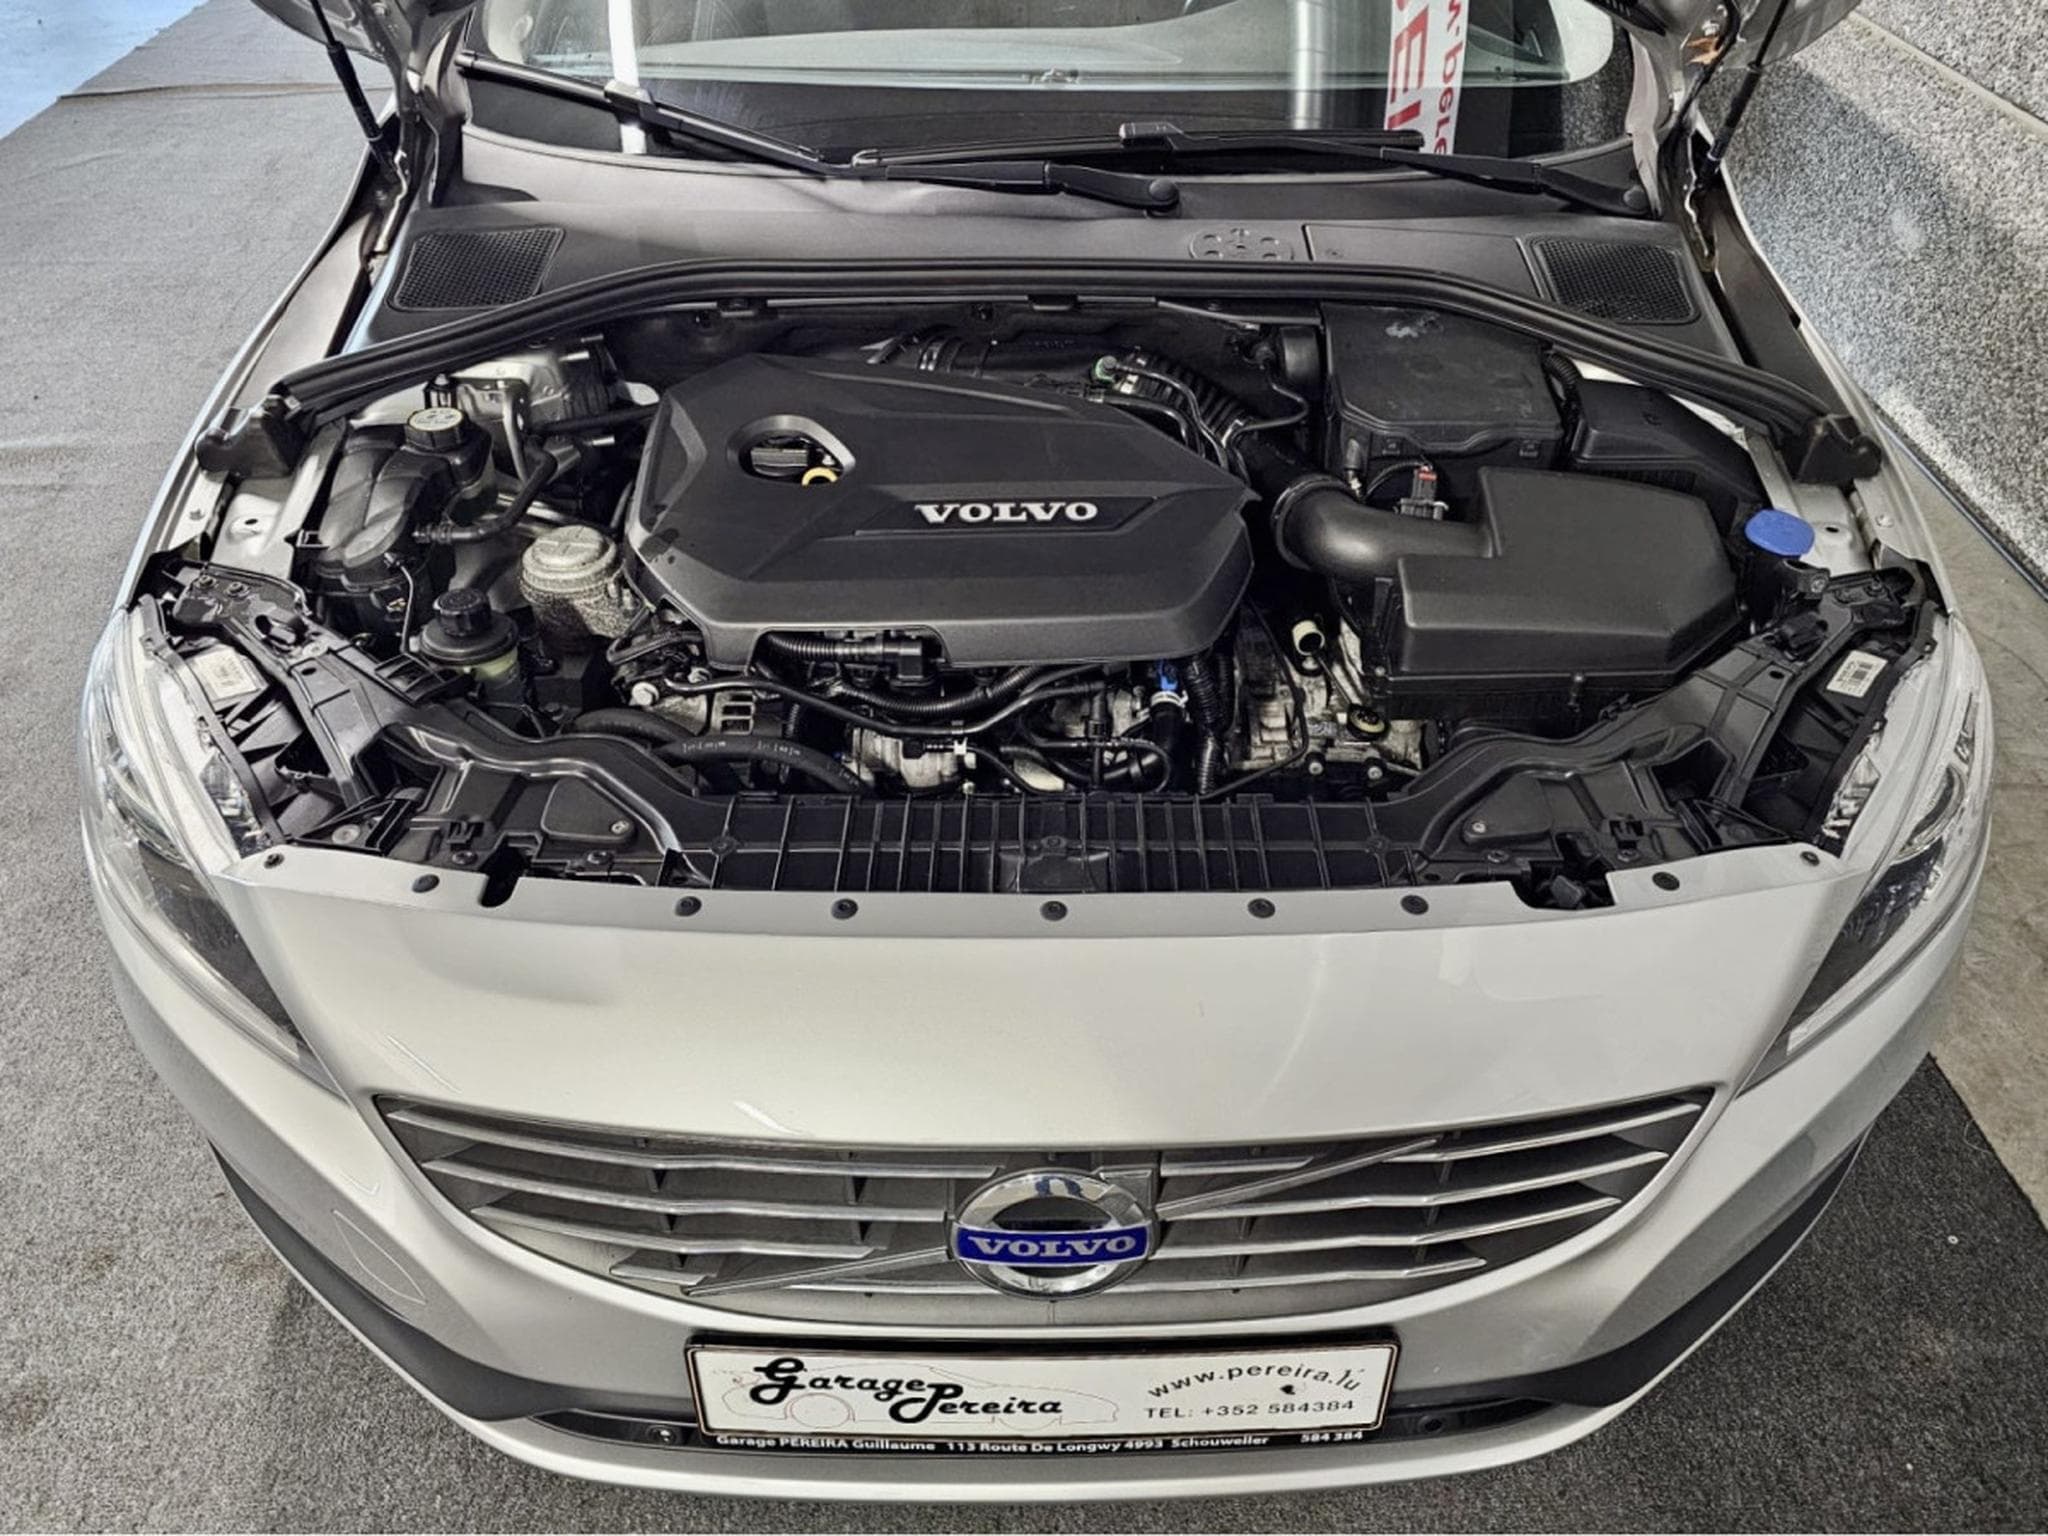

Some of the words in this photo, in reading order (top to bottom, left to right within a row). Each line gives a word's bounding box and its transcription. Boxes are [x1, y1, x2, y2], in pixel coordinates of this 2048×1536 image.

[914, 502, 1098, 524] VOLVO
[968, 1235, 1136, 1257] VOLVO
[749, 1357, 925, 1404] Garage
[889, 1383, 1063, 1424] Pereira
[1148, 1363, 1362, 1398] www.pereira.lu
[1144, 1407, 1194, 1419] TEL:
[1204, 1404, 1259, 1417] +352
[1268, 1400, 1354, 1414] 584384
[716, 1435, 776, 1447] Garage
[779, 1437, 848, 1449] PEREIRA
[852, 1439, 936, 1451] Guillaume
[948, 1442, 976, 1452] 113
[980, 1442, 1028, 1452] Route
[1031, 1442, 1053, 1452] De
[1057, 1441, 1121, 1452] Longwy
[1125, 1439, 1163, 1449] 4993
